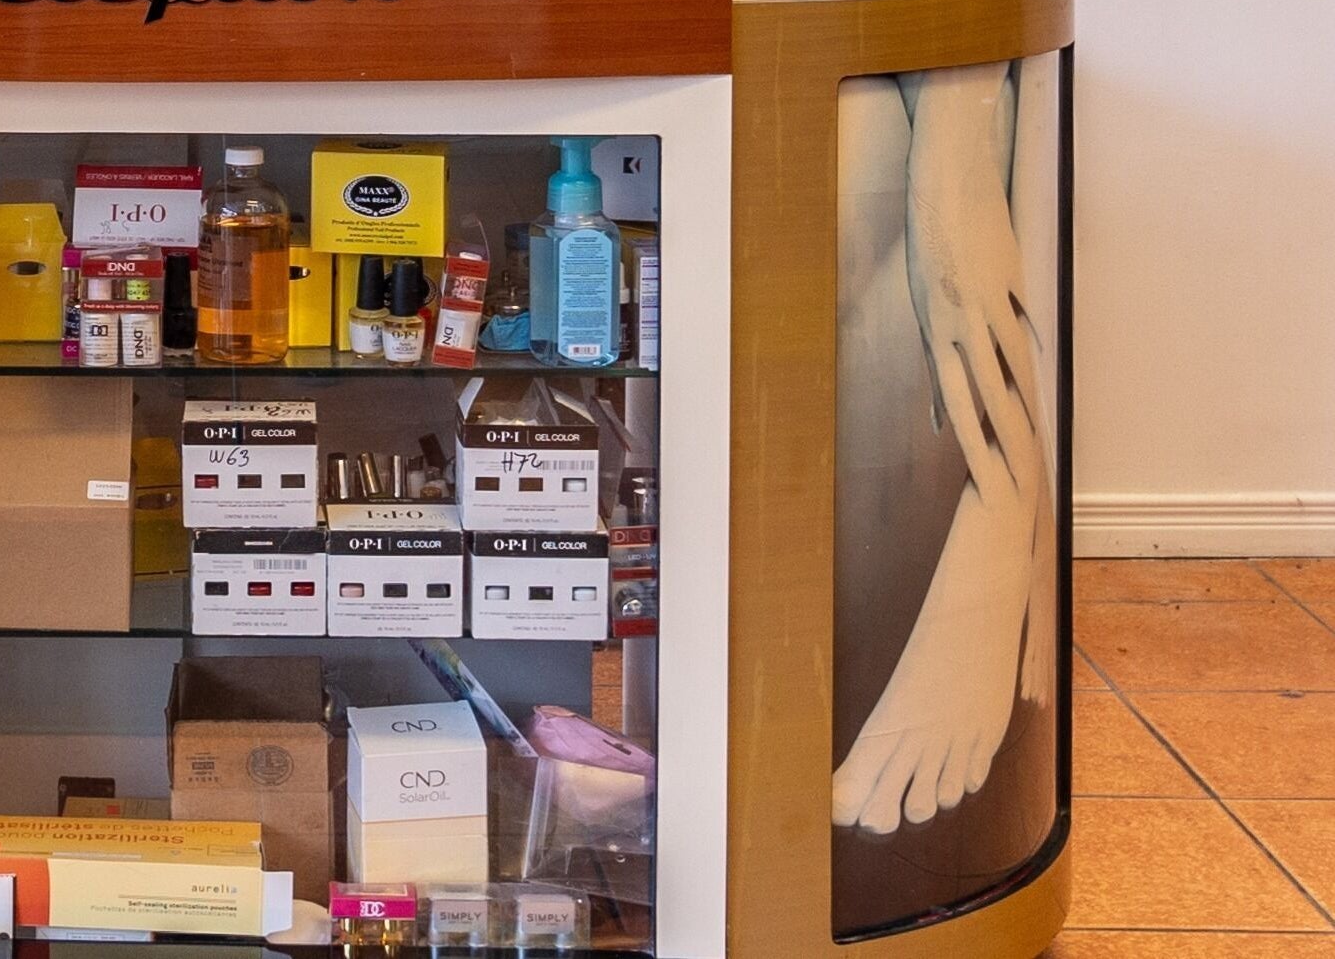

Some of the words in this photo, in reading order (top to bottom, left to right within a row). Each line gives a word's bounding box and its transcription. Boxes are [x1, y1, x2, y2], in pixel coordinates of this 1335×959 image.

[442, 326, 455, 346] DN
[391, 718, 438, 734] CND
[400, 769, 447, 789] CND
[399, 791, 448, 805] SolarOil
[52, 831, 185, 844] Sterilization
[191, 884, 238, 894] aurelia
[440, 911, 483, 922] SIMPLY
[526, 912, 570, 924] SIMPLY
